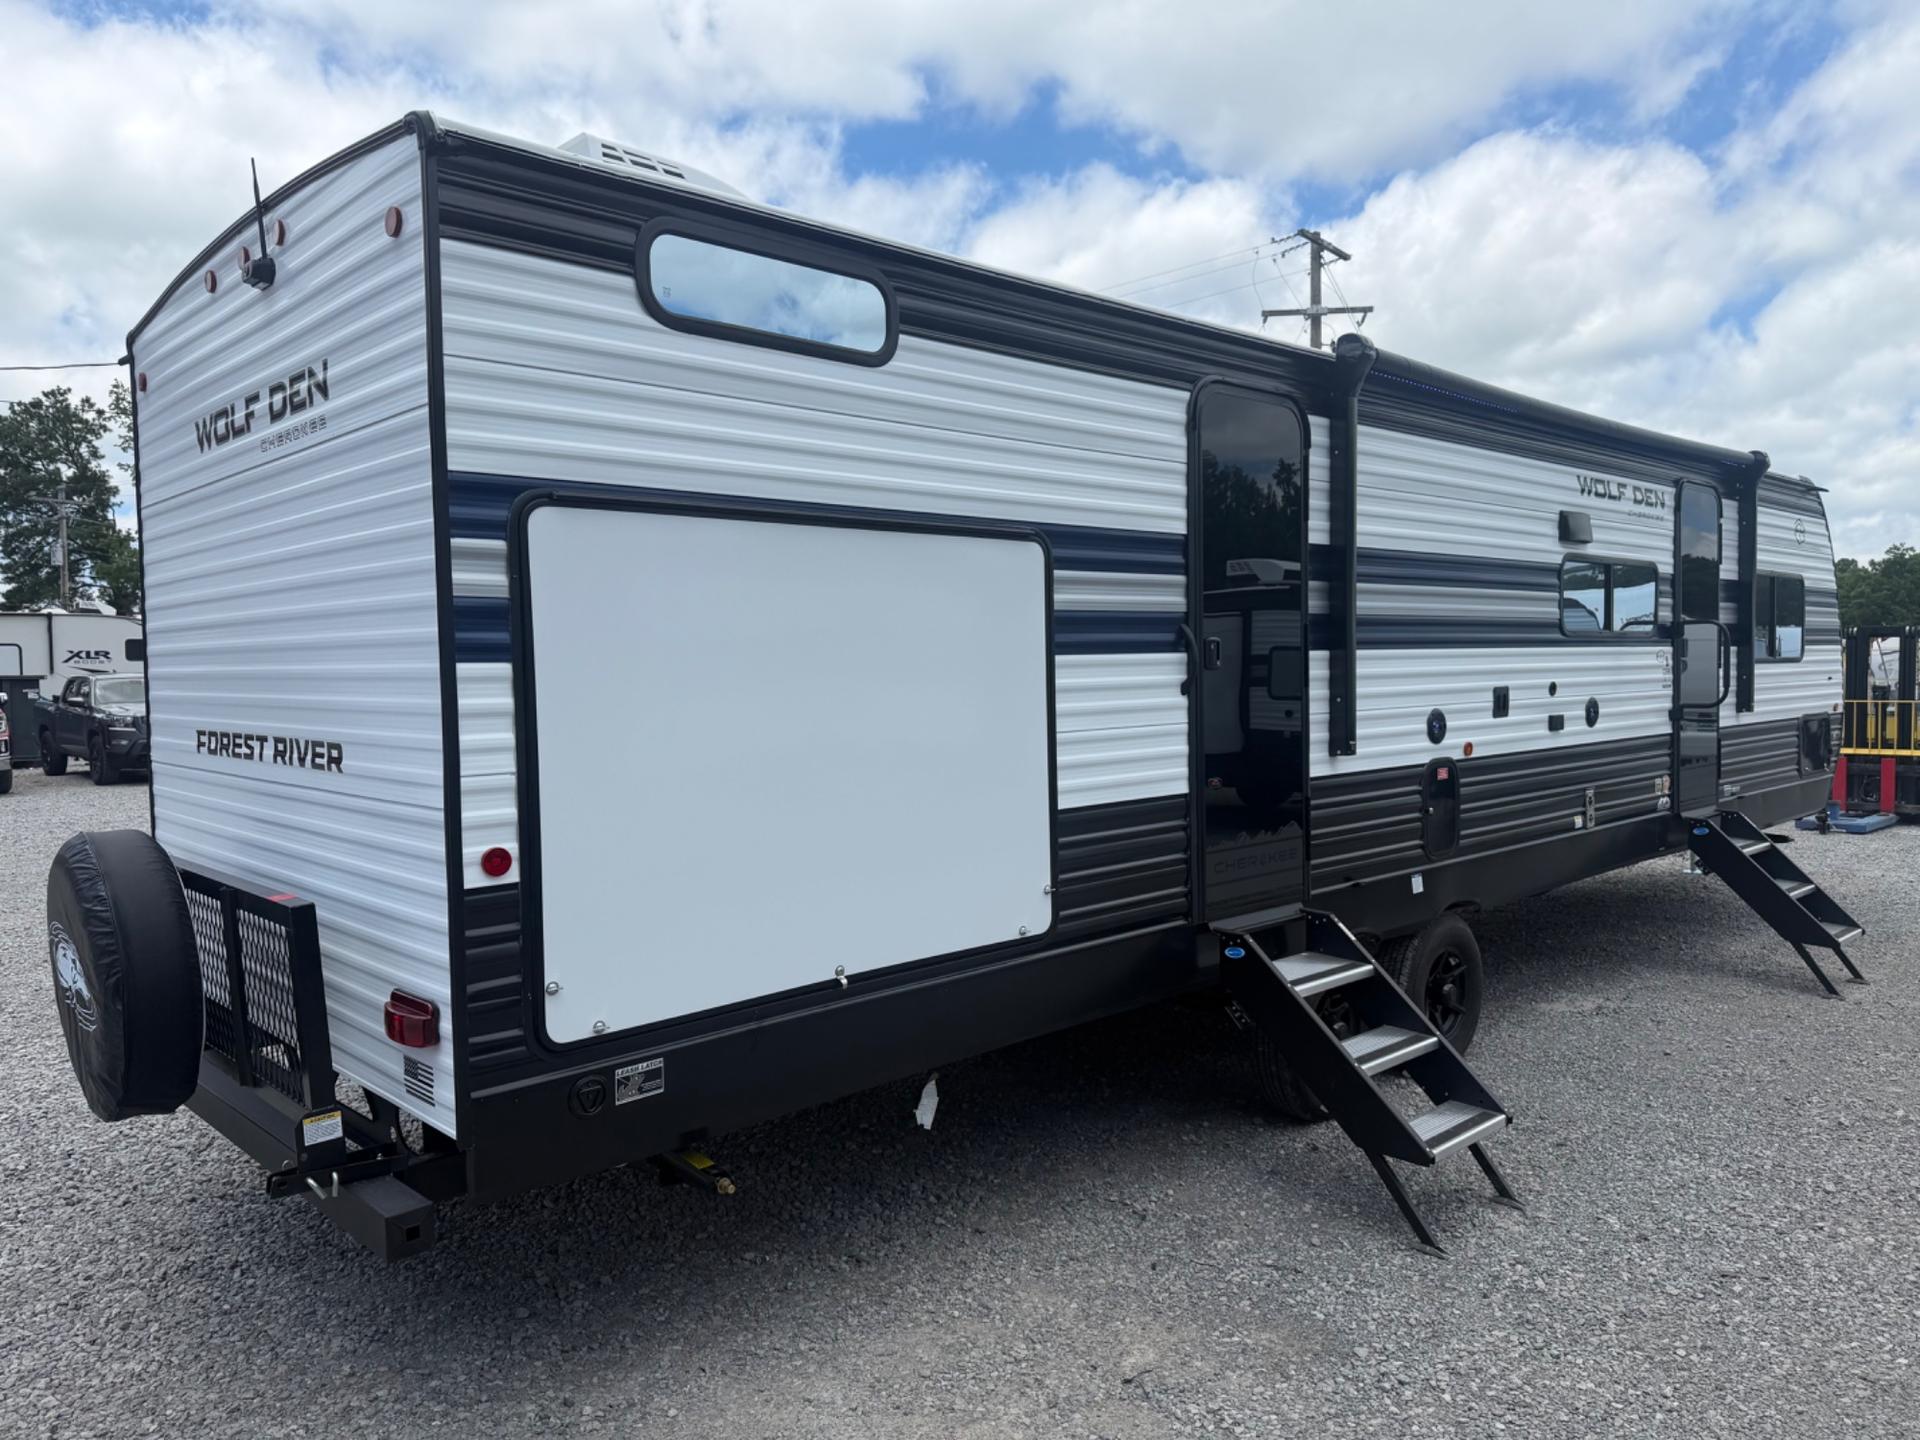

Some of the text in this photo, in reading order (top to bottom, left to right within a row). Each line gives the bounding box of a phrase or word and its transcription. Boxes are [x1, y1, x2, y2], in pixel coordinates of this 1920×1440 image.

[194, 358, 329, 454] WOLF DEN
[1576, 475, 1666, 510] WOLF DEN
[62, 650, 112, 664] XLR
[196, 729, 344, 774] FOREST RIVER
